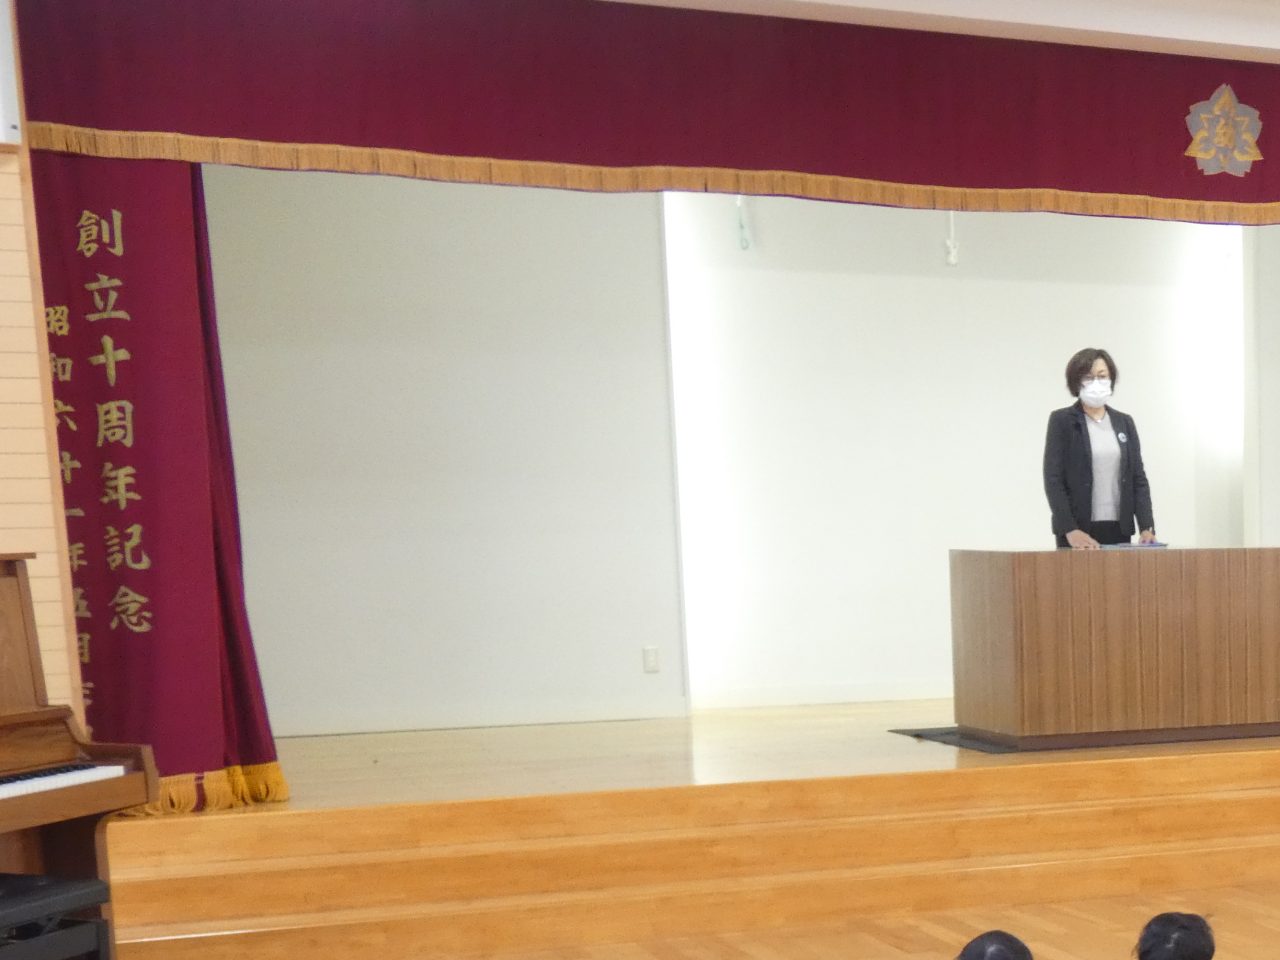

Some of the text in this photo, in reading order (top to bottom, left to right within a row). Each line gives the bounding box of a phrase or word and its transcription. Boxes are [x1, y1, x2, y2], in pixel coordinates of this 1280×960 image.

[76, 208, 153, 635] 創立十周年記念
